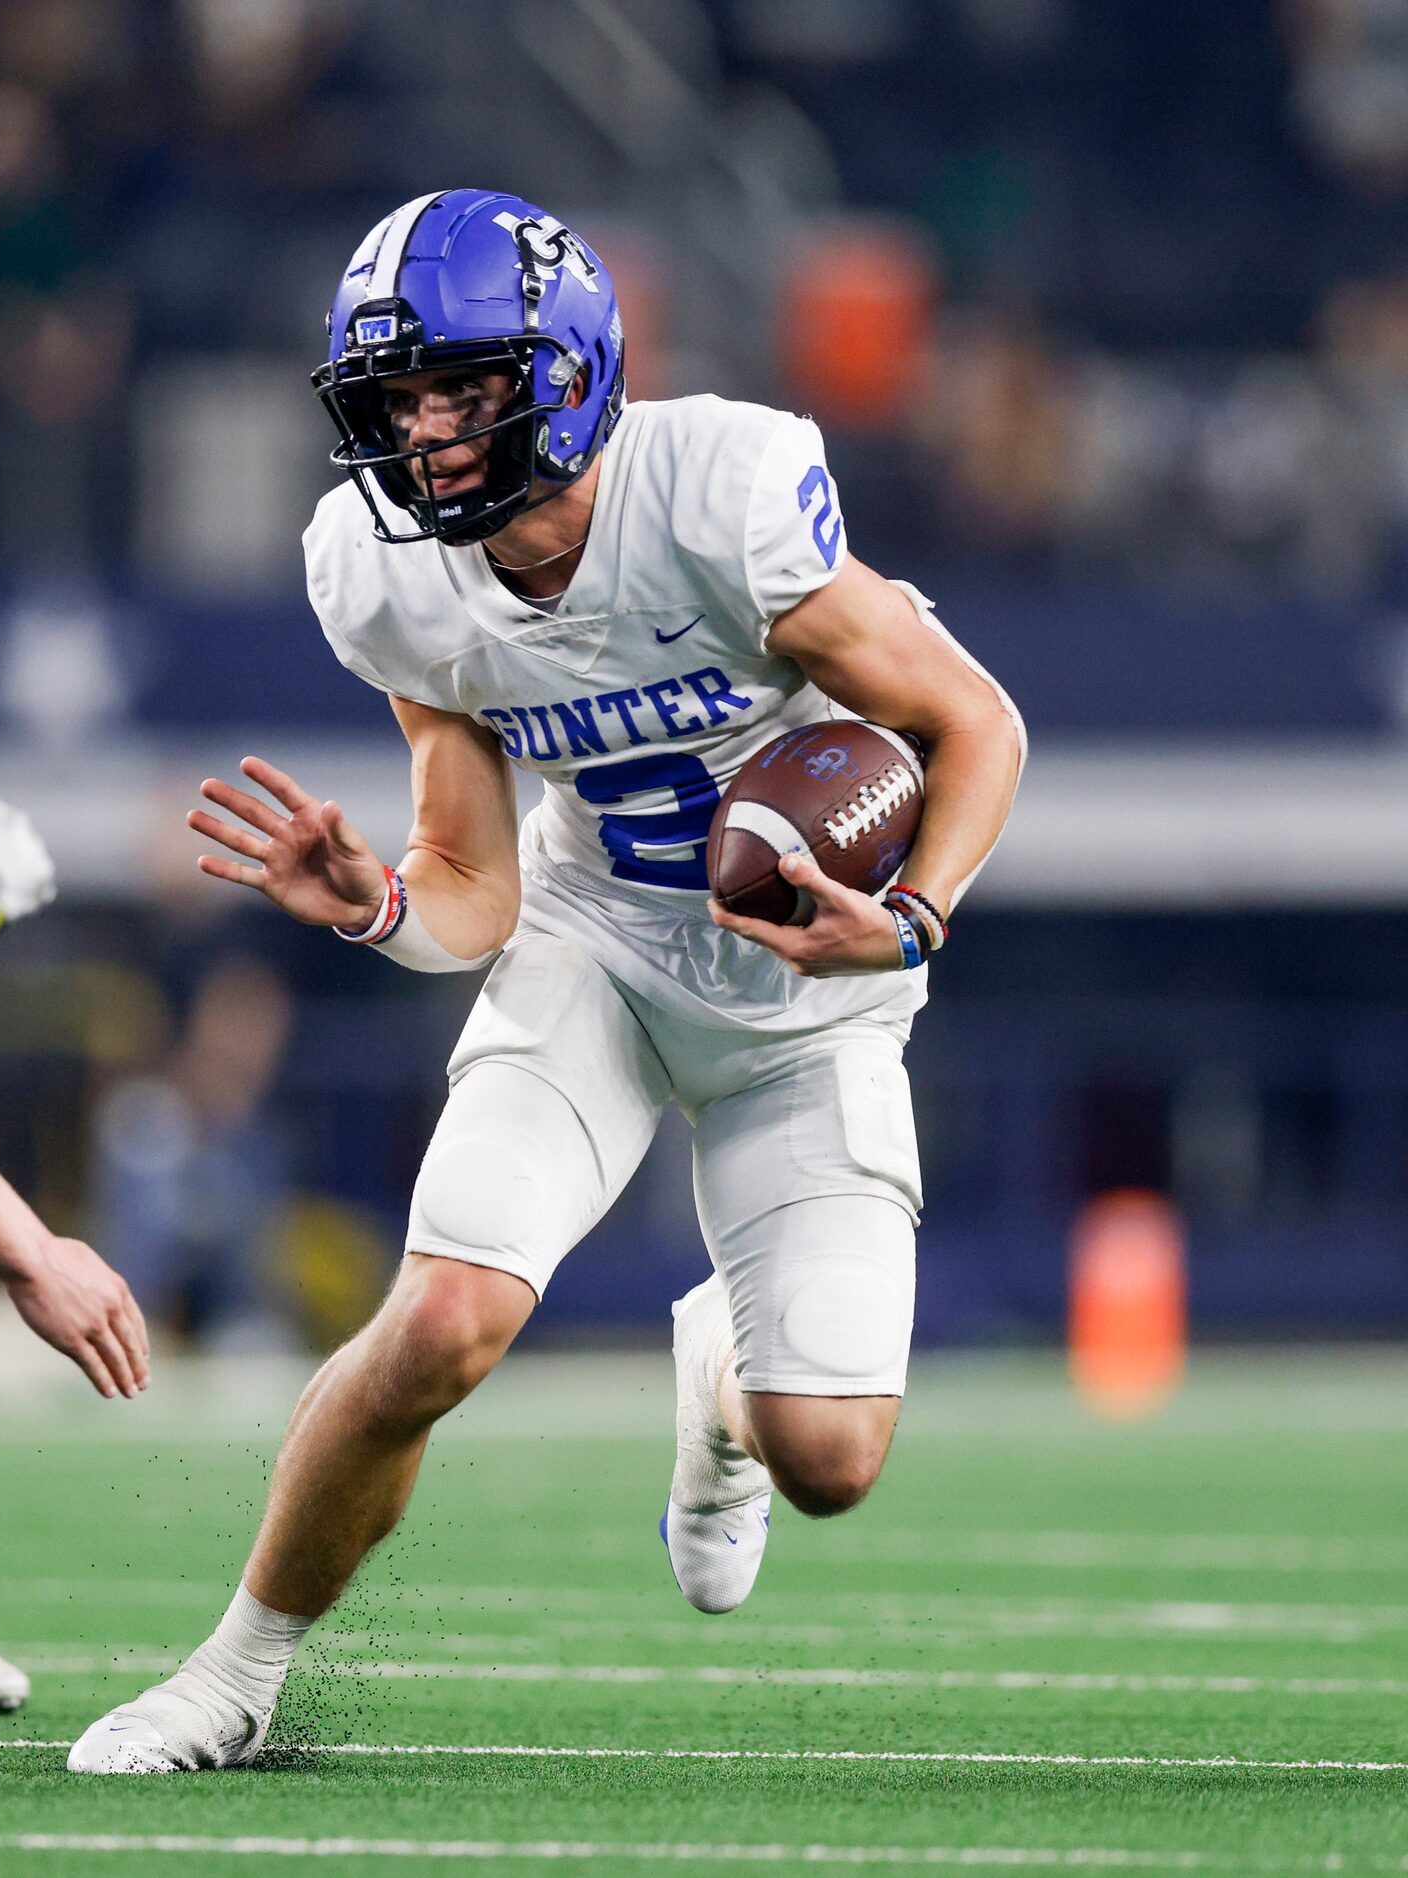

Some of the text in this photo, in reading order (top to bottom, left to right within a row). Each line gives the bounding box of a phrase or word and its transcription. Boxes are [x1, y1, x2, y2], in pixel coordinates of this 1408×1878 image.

[360, 319, 392, 341] TPW
[797, 465, 841, 570] 2
[481, 666, 754, 762] GUNTER
[574, 751, 722, 891] 2
